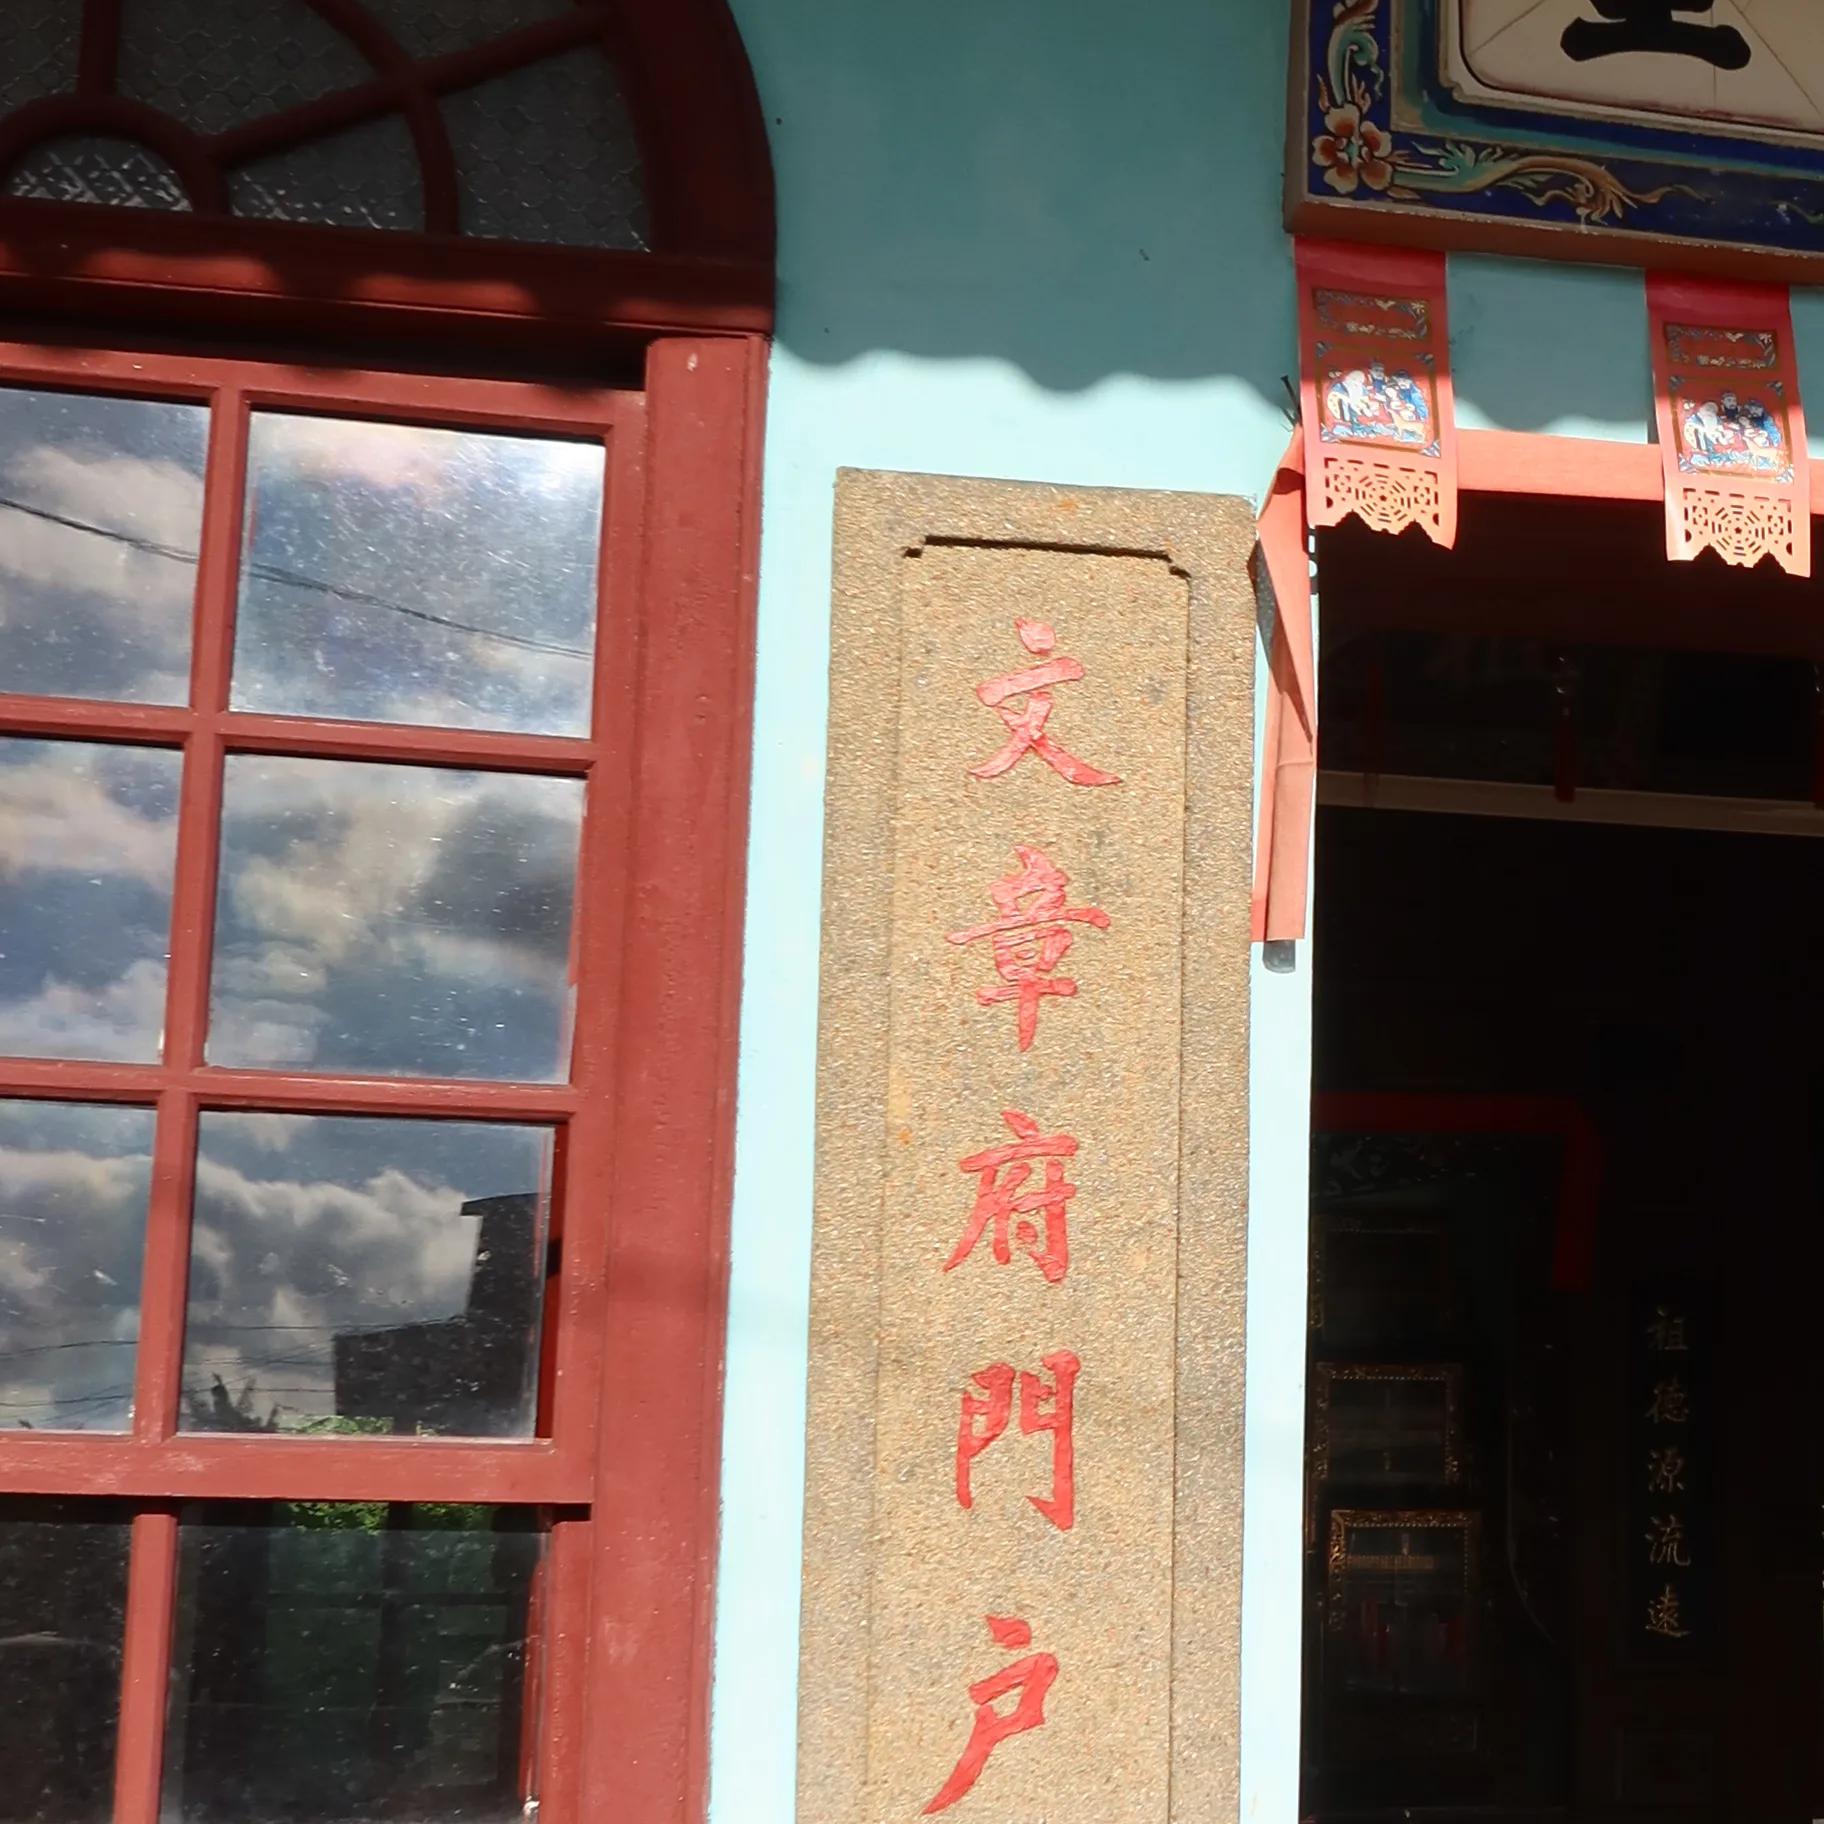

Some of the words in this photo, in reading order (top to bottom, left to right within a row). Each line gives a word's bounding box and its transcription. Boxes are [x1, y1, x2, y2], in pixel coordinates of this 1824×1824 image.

[1643, 1304, 1693, 1639] 祖德源流遠
